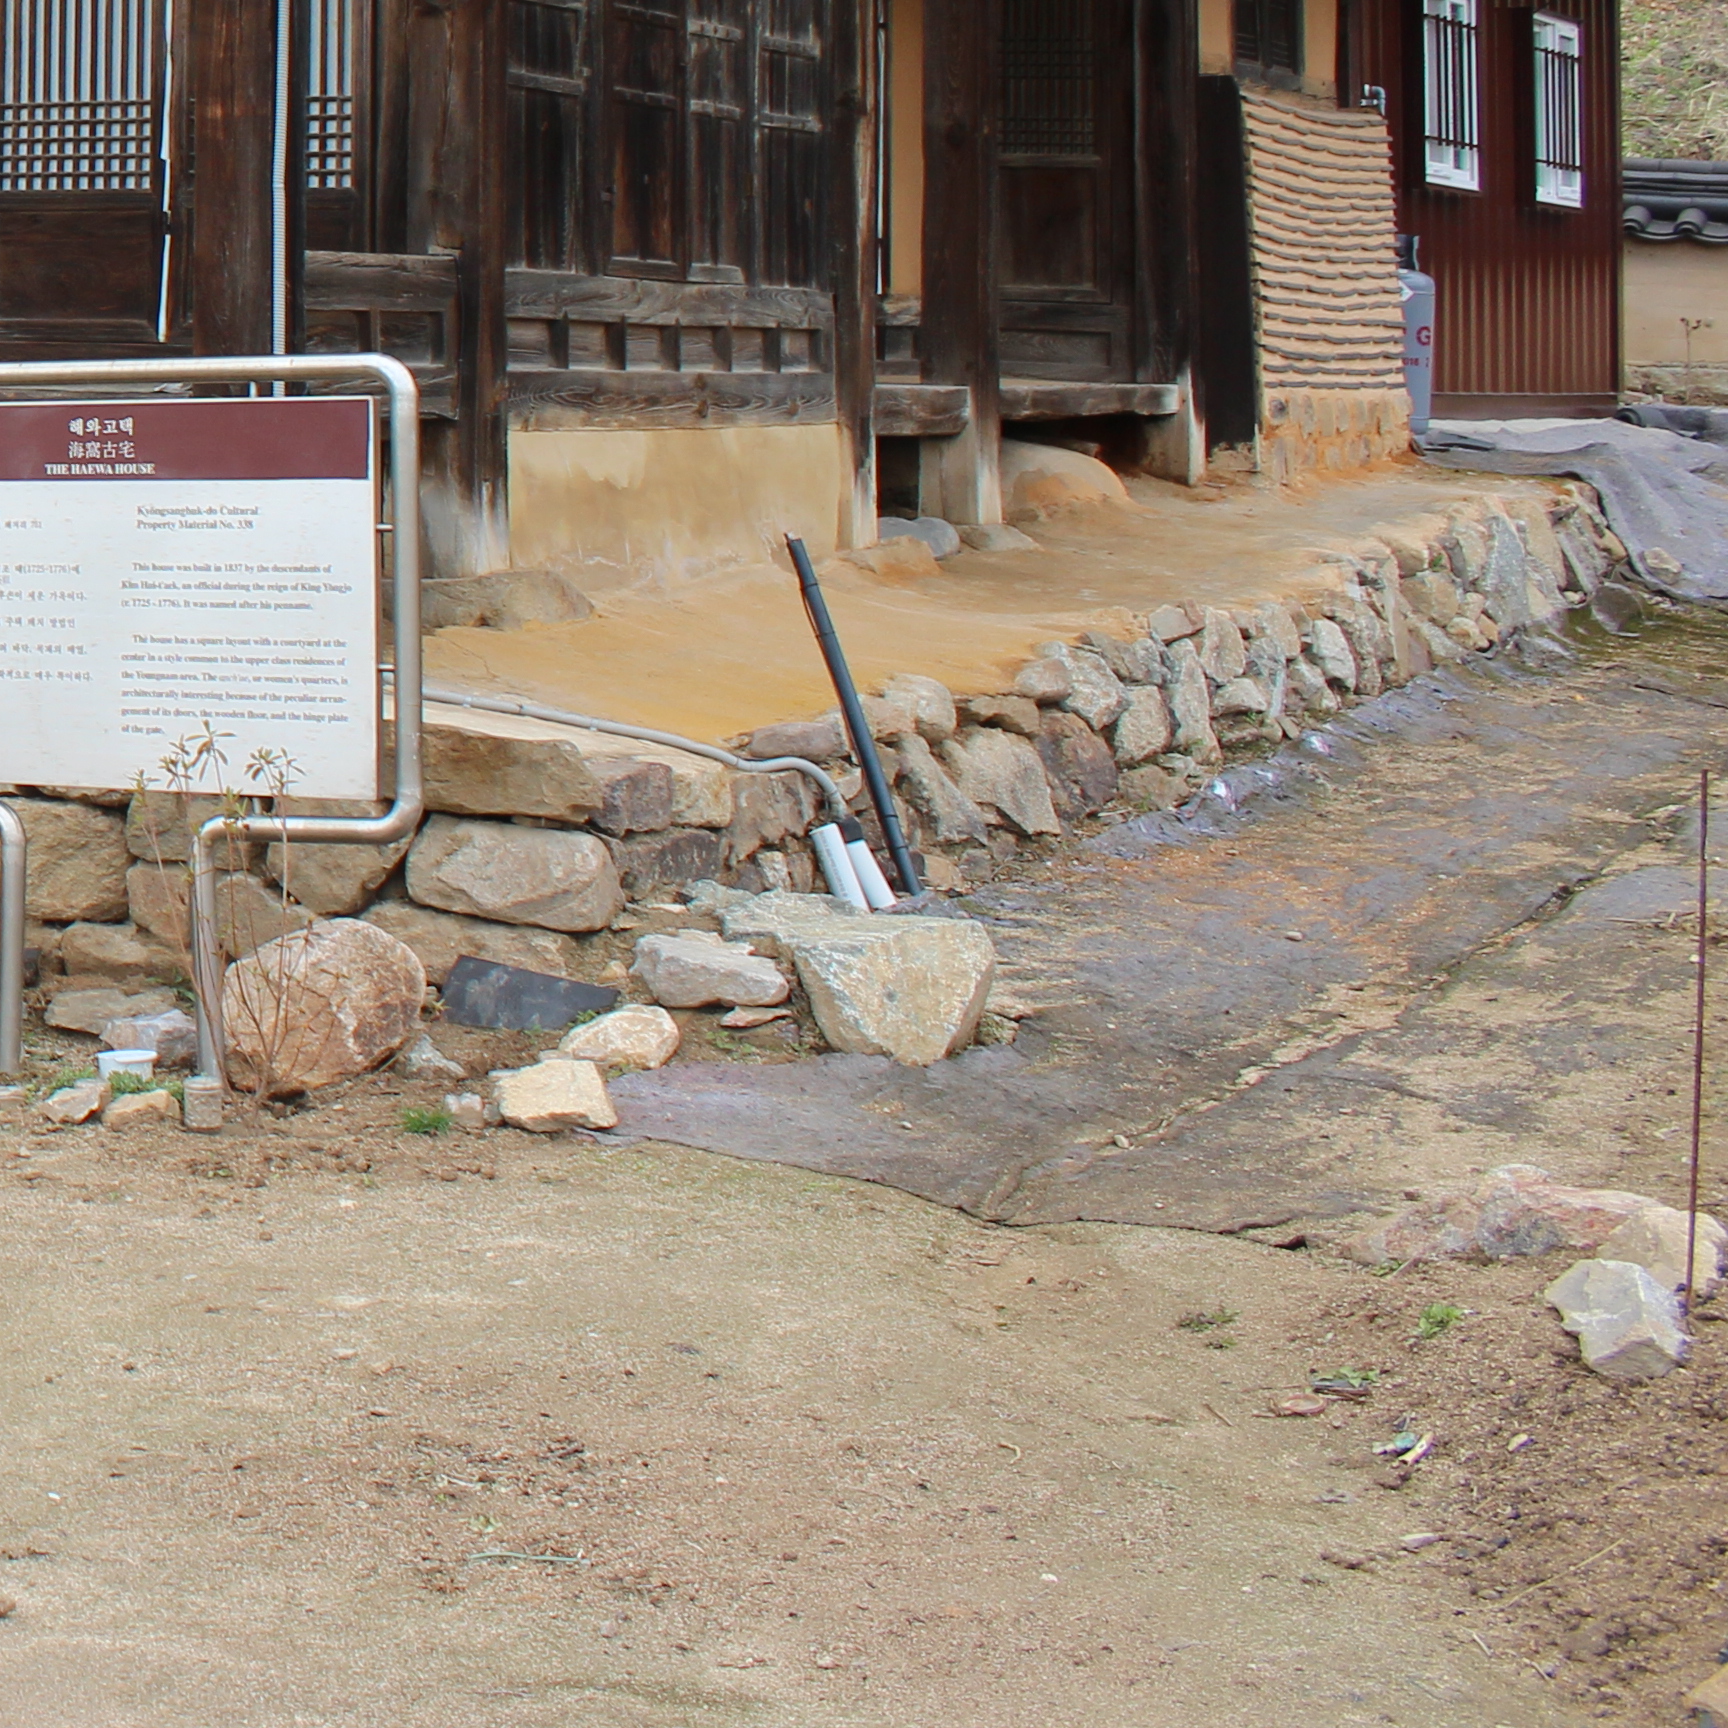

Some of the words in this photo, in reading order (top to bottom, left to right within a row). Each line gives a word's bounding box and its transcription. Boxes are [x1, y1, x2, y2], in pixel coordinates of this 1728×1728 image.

[68, 417, 134, 437] 해와고택
[44, 463, 69, 475] THE
[70, 463, 114, 475] HAEWA
[114, 463, 156, 475] HOUSE
[219, 505, 259, 516] Cultural
[137, 519, 176, 532] Property
[178, 519, 218, 529] Material
[219, 520, 235, 529] No.
[237, 520, 254, 529] 338
[132, 562, 150, 571] This
[151, 562, 174, 572] house
[193, 562, 212, 572] built
[214, 563, 222, 572] in
[224, 563, 243, 572] 1837
[244, 563, 255, 574] by
[257, 564, 270, 573] the
[271, 564, 321, 573] descendants
[323, 564, 332, 573] of
[121, 579, 139, 589] Kim
[194, 581, 222, 590] official
[223, 582, 251, 592] during
[252, 582, 265, 591] the
[267, 582, 289, 593] reign
[290, 582, 300, 591] of
[300, 582, 322, 593] King
[132, 598, 151, 608] 1725
[209, 600, 237, 609] named
[238, 600, 259, 610] after
[260, 600, 272, 610] his
[132, 634, 148, 643] The
[149, 635, 173, 644] house
[174, 635, 189, 644] has
[196, 638, 224, 647] square
[225, 636, 251, 647] layout
[252, 637, 272, 646] with
[280, 638, 322, 649] courtyard
[333, 639, 347, 647] the
[121, 653, 146, 661] center
[147, 652, 156, 661] in
[164, 653, 183, 663] style
[220, 655, 230, 663] to
[230, 655, 244, 663] the
[245, 657, 270, 666] upper
[271, 656, 291, 665] class
[292, 656, 335, 666] residences
[336, 657, 346, 666] of
[121, 670, 134, 679] the
[201, 672, 217, 681] The
[301, 676, 339, 685] quarters,
[341, 676, 348, 684] is
[121, 689, 179, 700] architecturally
[181, 691, 224, 701] interesting
[225, 691, 257, 701] because
[258, 692, 268, 701] of
[269, 693, 282, 702] the
[284, 694, 318, 704] peculiar
[121, 708, 150, 717] gement
[151, 707, 161, 716] of
[161, 708, 172, 716] its
[199, 709, 213, 718] the
[214, 710, 246, 719] wooden
[270, 711, 286, 720] and
[288, 712, 302, 721] the
[303, 712, 326, 723] hinge
[327, 713, 349, 723] plate
[121, 724, 131, 733] of
[131, 725, 145, 733] the
